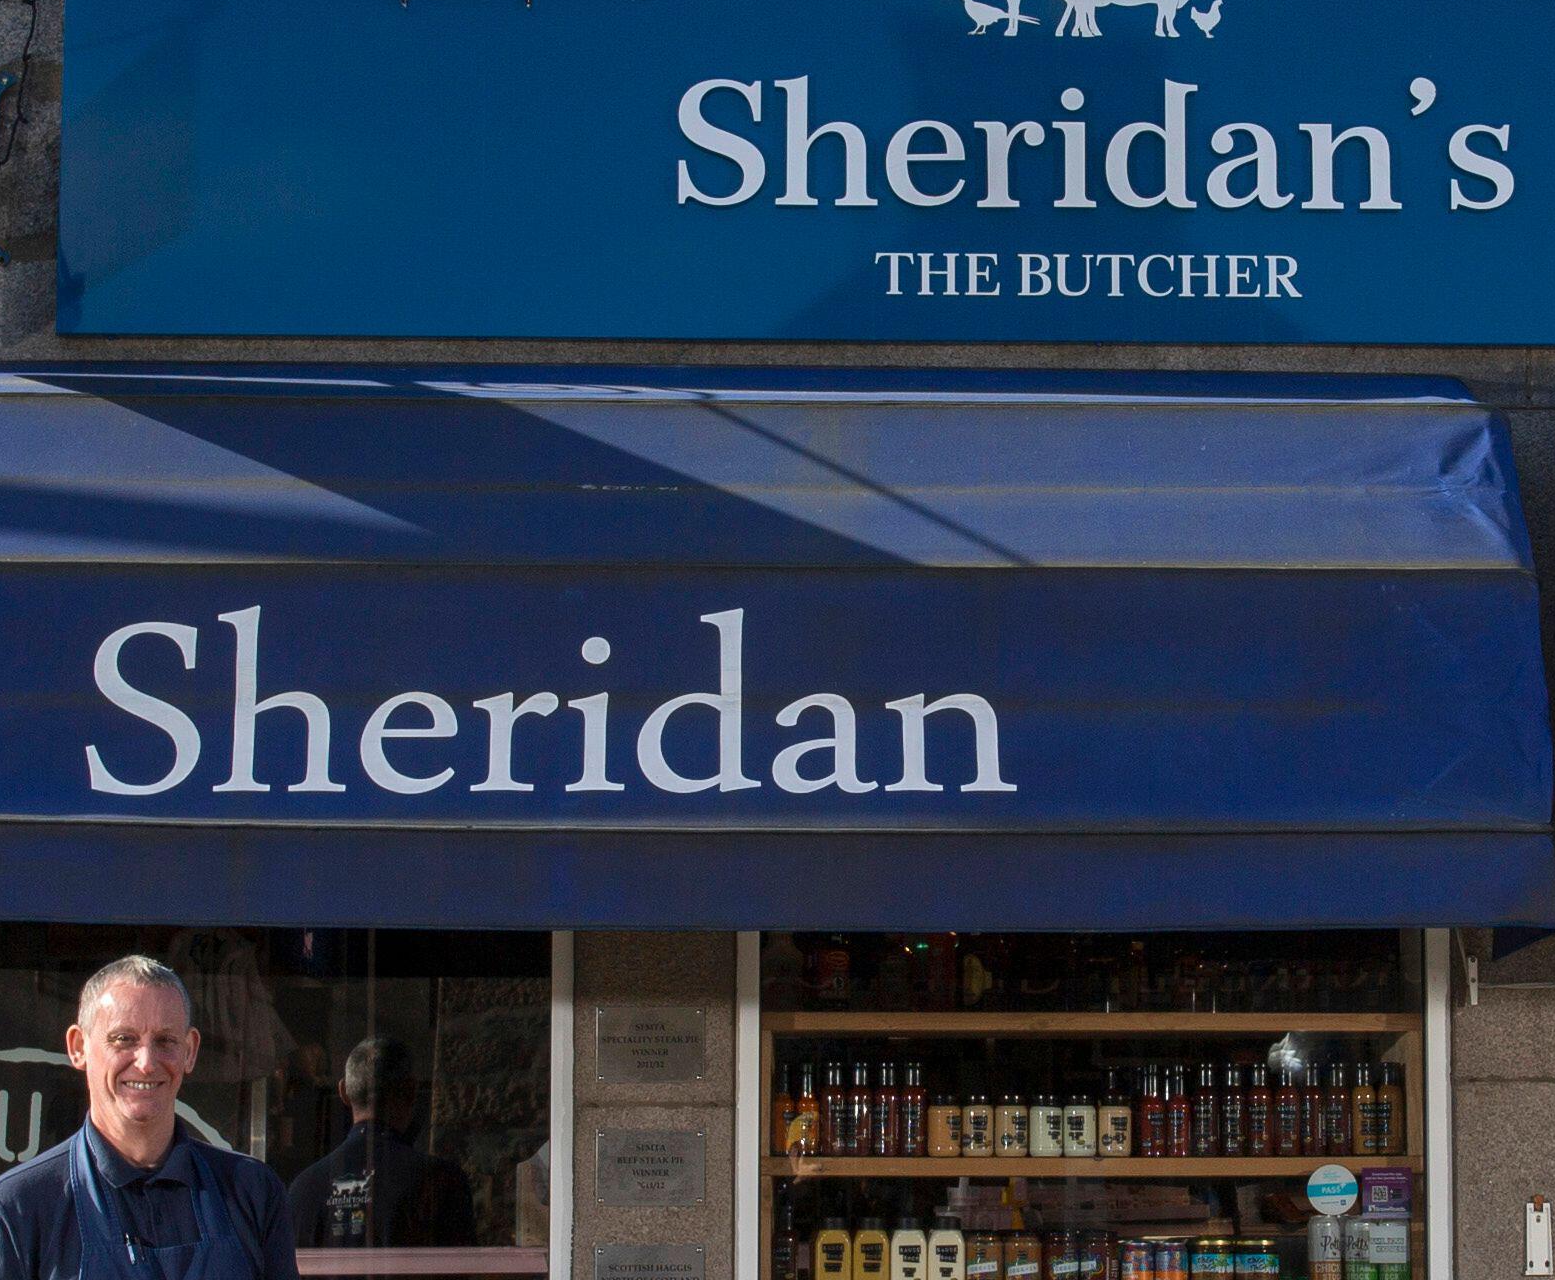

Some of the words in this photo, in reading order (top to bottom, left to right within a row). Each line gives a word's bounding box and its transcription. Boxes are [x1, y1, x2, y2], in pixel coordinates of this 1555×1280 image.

[673, 74, 1516, 212] Sheridan's
[875, 252, 1001, 297] THE
[1017, 252, 1303, 299] BUTCHER
[85, 605, 1018, 796] Sheridan
[608, 1263, 654, 1272] SCOTTISH
[656, 1263, 692, 1272] HAGGIS
